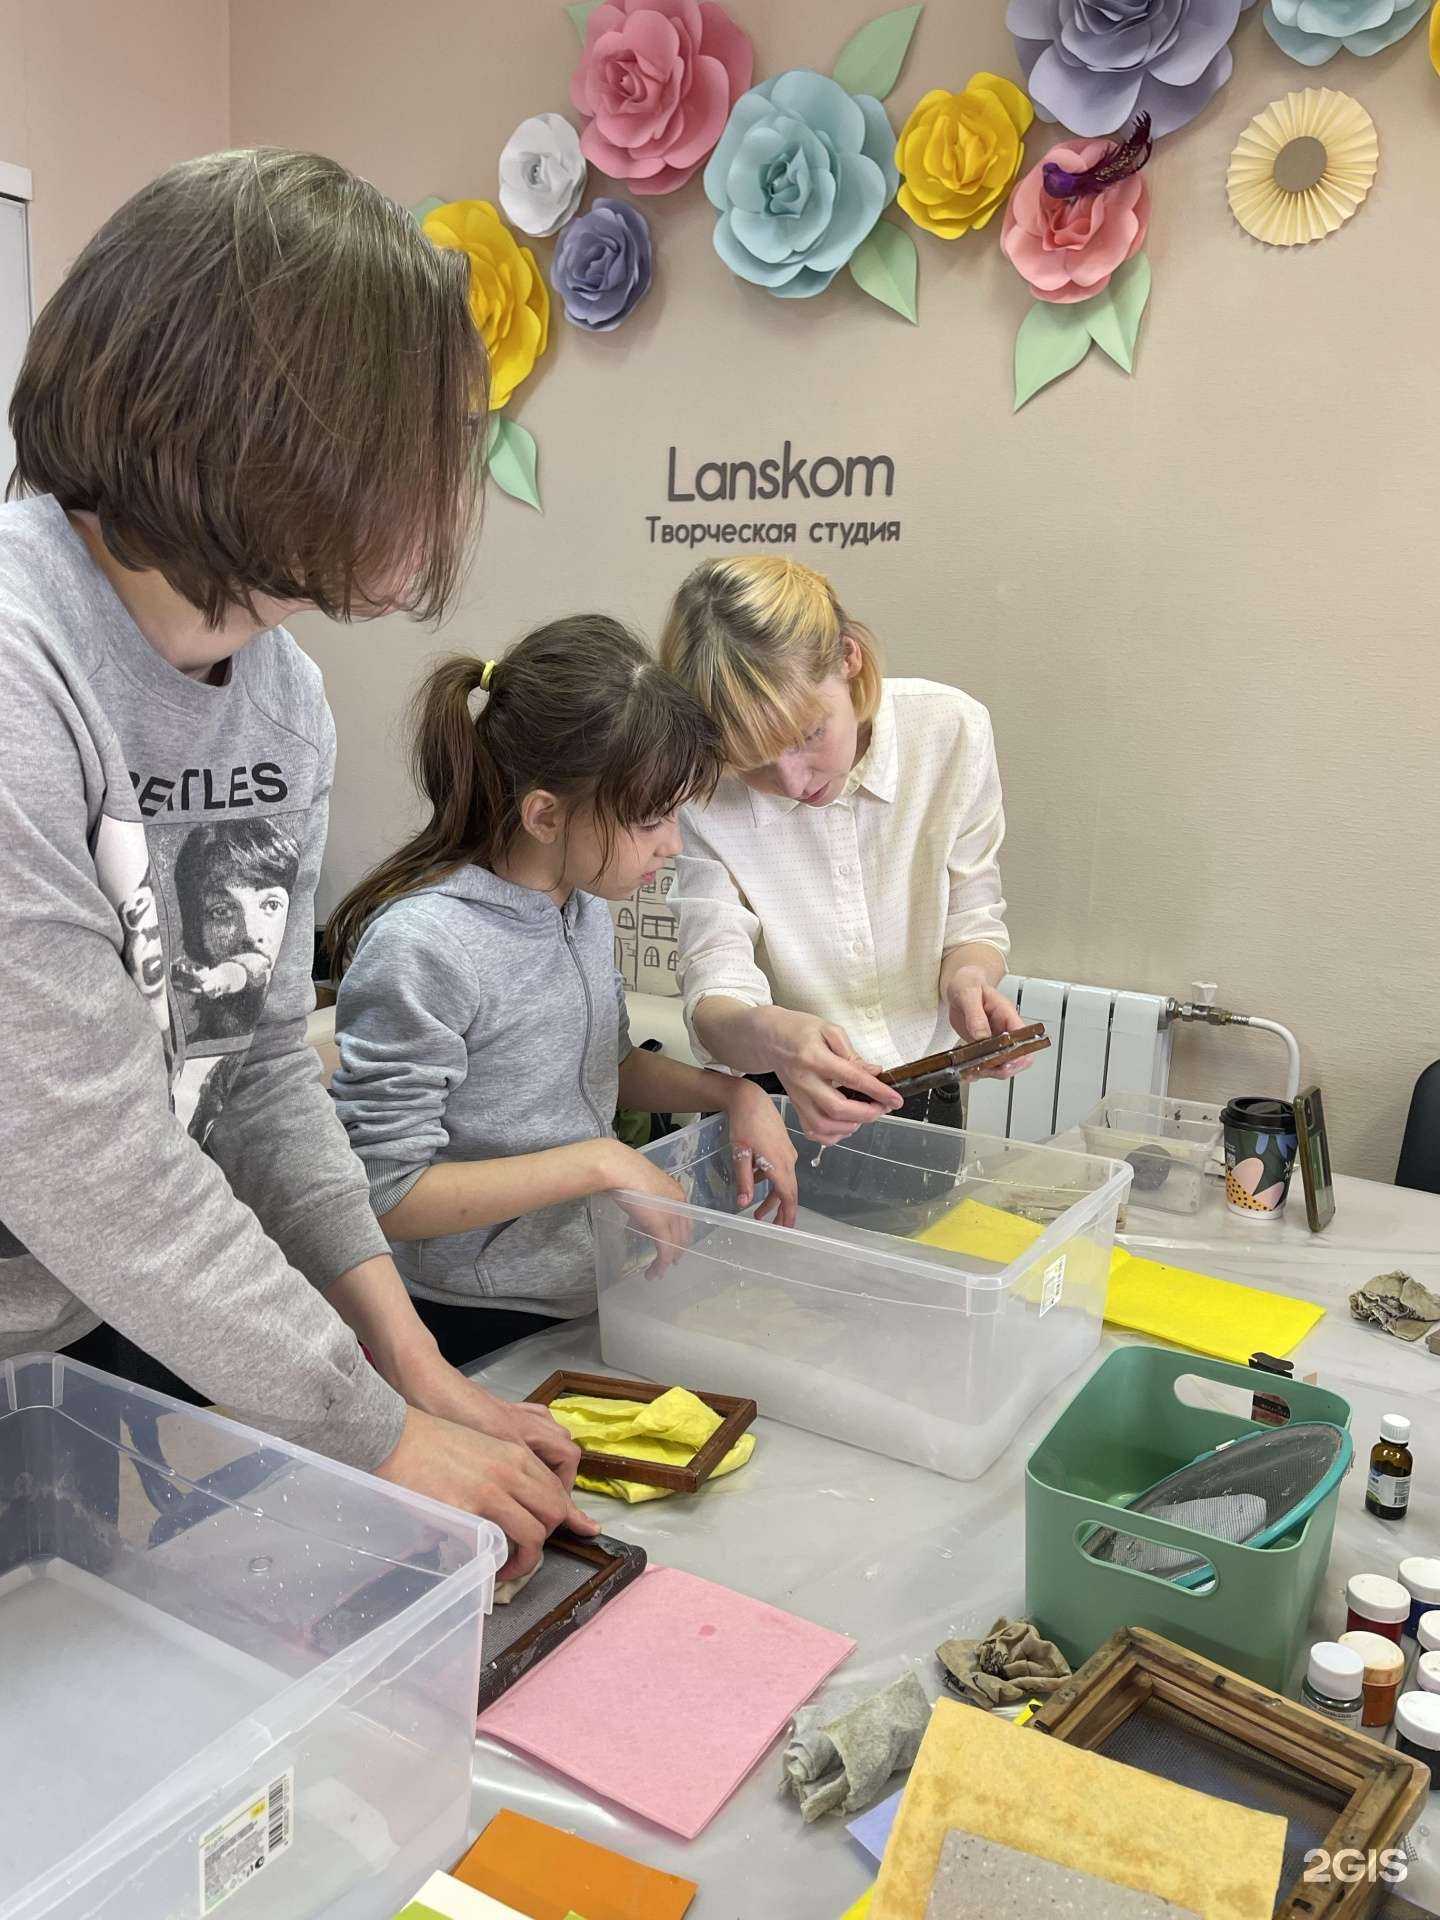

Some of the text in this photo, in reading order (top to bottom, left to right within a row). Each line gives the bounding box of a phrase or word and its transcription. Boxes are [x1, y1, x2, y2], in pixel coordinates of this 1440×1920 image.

[667, 440, 895, 501] Lanskom
[645, 516, 901, 549] Творческая студия
[129, 761, 288, 817] ETLES
